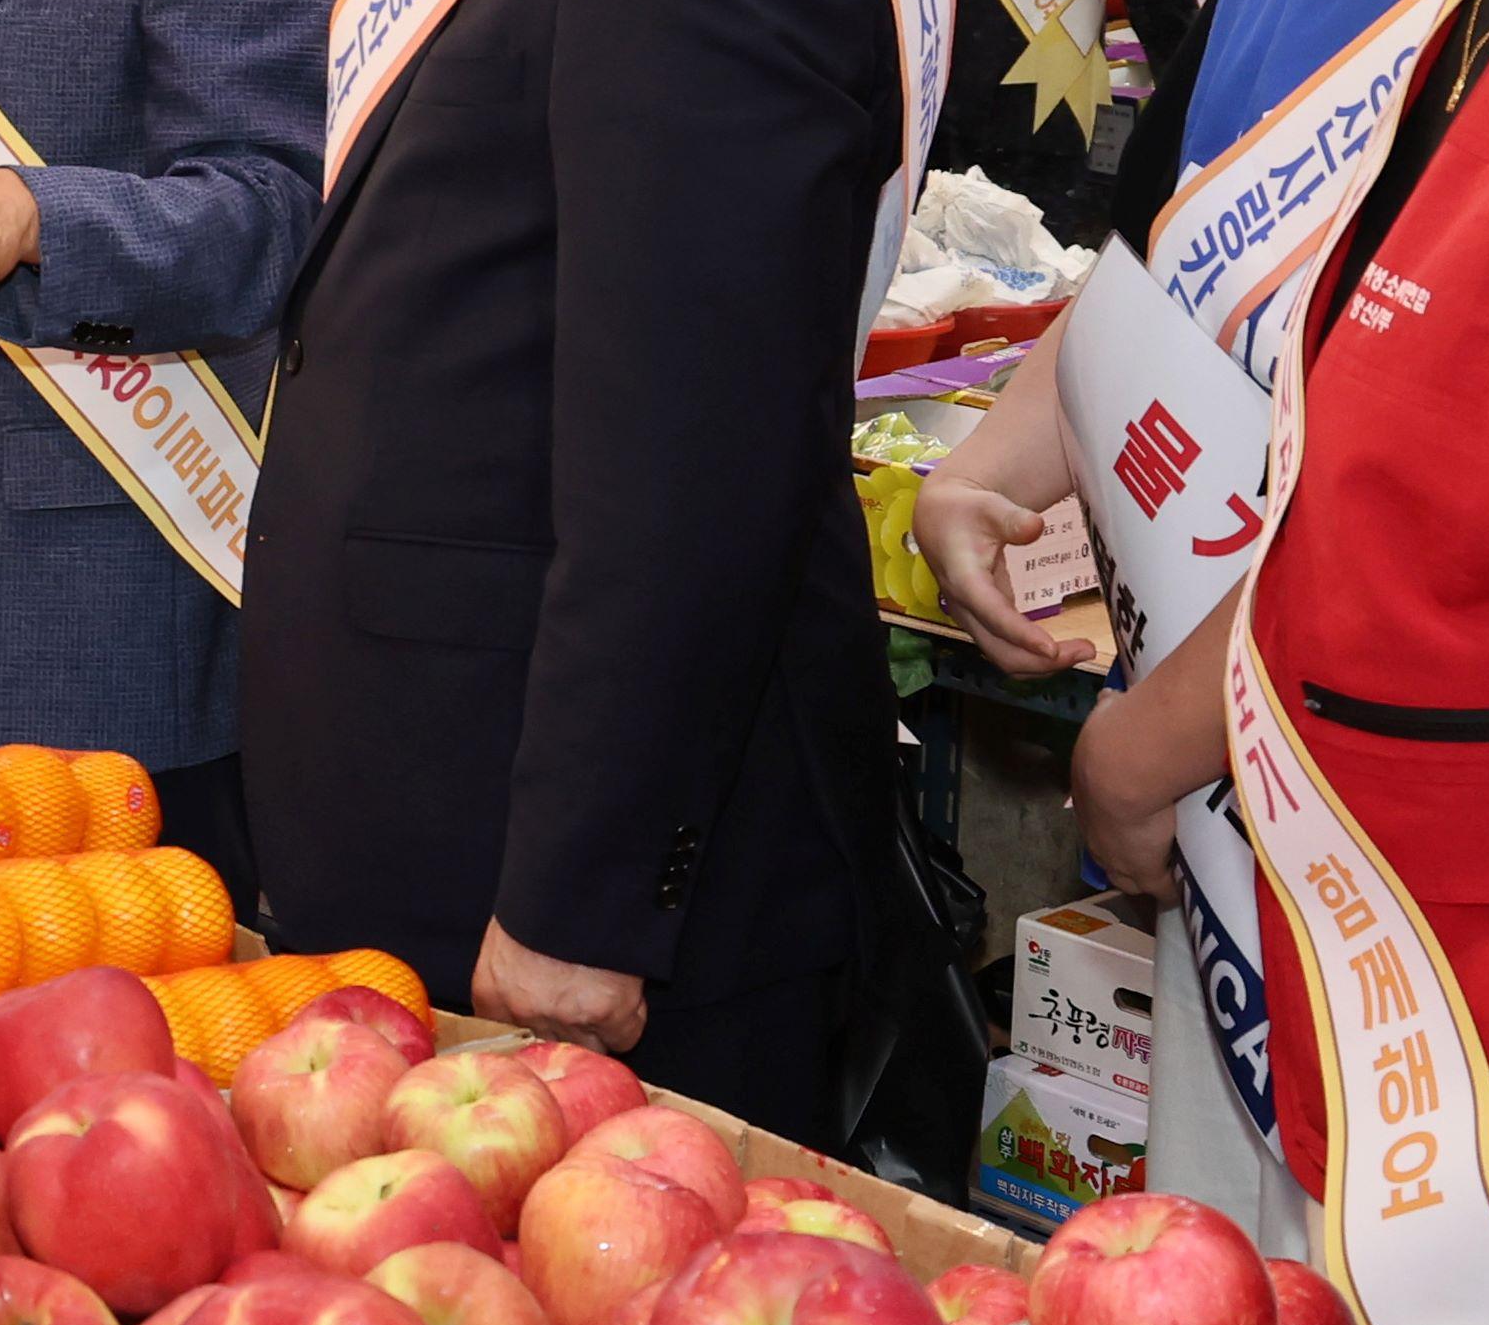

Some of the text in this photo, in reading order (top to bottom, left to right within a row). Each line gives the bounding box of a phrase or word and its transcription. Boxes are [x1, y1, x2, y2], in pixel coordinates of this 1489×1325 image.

[1028, 987, 1111, 1049] 추풍령
[1304, 852, 1444, 1220] 함께해요
[1000, 1128, 1012, 1159] 상주
[995, 1179, 1077, 1220] 백화자두작목
